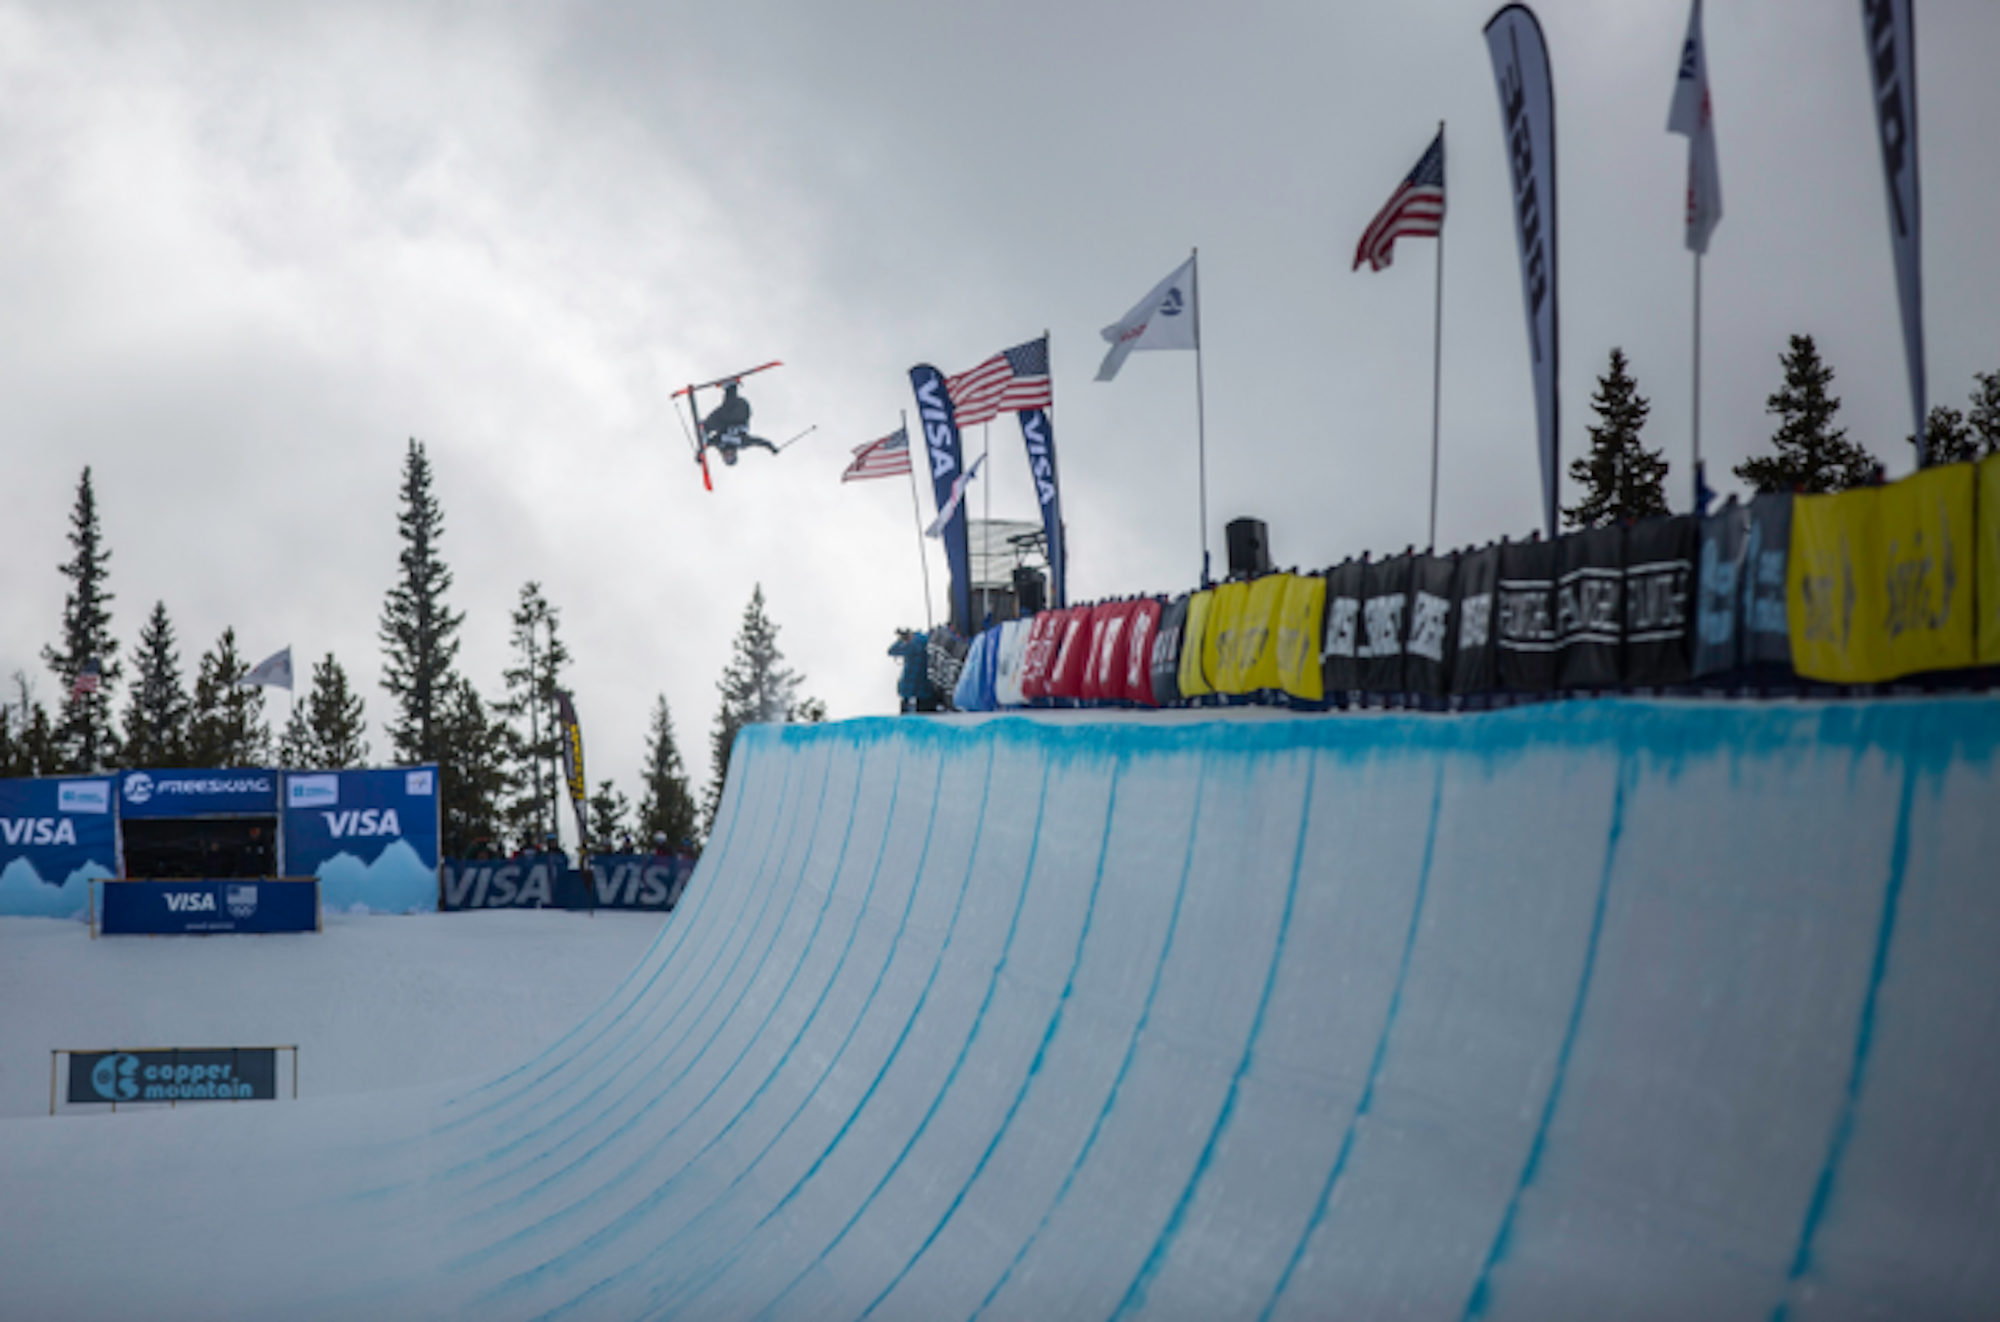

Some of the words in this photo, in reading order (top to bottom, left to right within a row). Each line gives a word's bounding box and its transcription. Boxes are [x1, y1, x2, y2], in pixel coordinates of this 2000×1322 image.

[917, 372, 956, 479] VISA
[1023, 411, 1056, 506] VISA
[0, 817, 76, 846] VISA
[321, 809, 401, 837] VISA
[445, 866, 552, 906] VISA
[164, 893, 216, 911] VISA
[144, 1064, 232, 1083] copper
[145, 1079, 252, 1098] mountain
